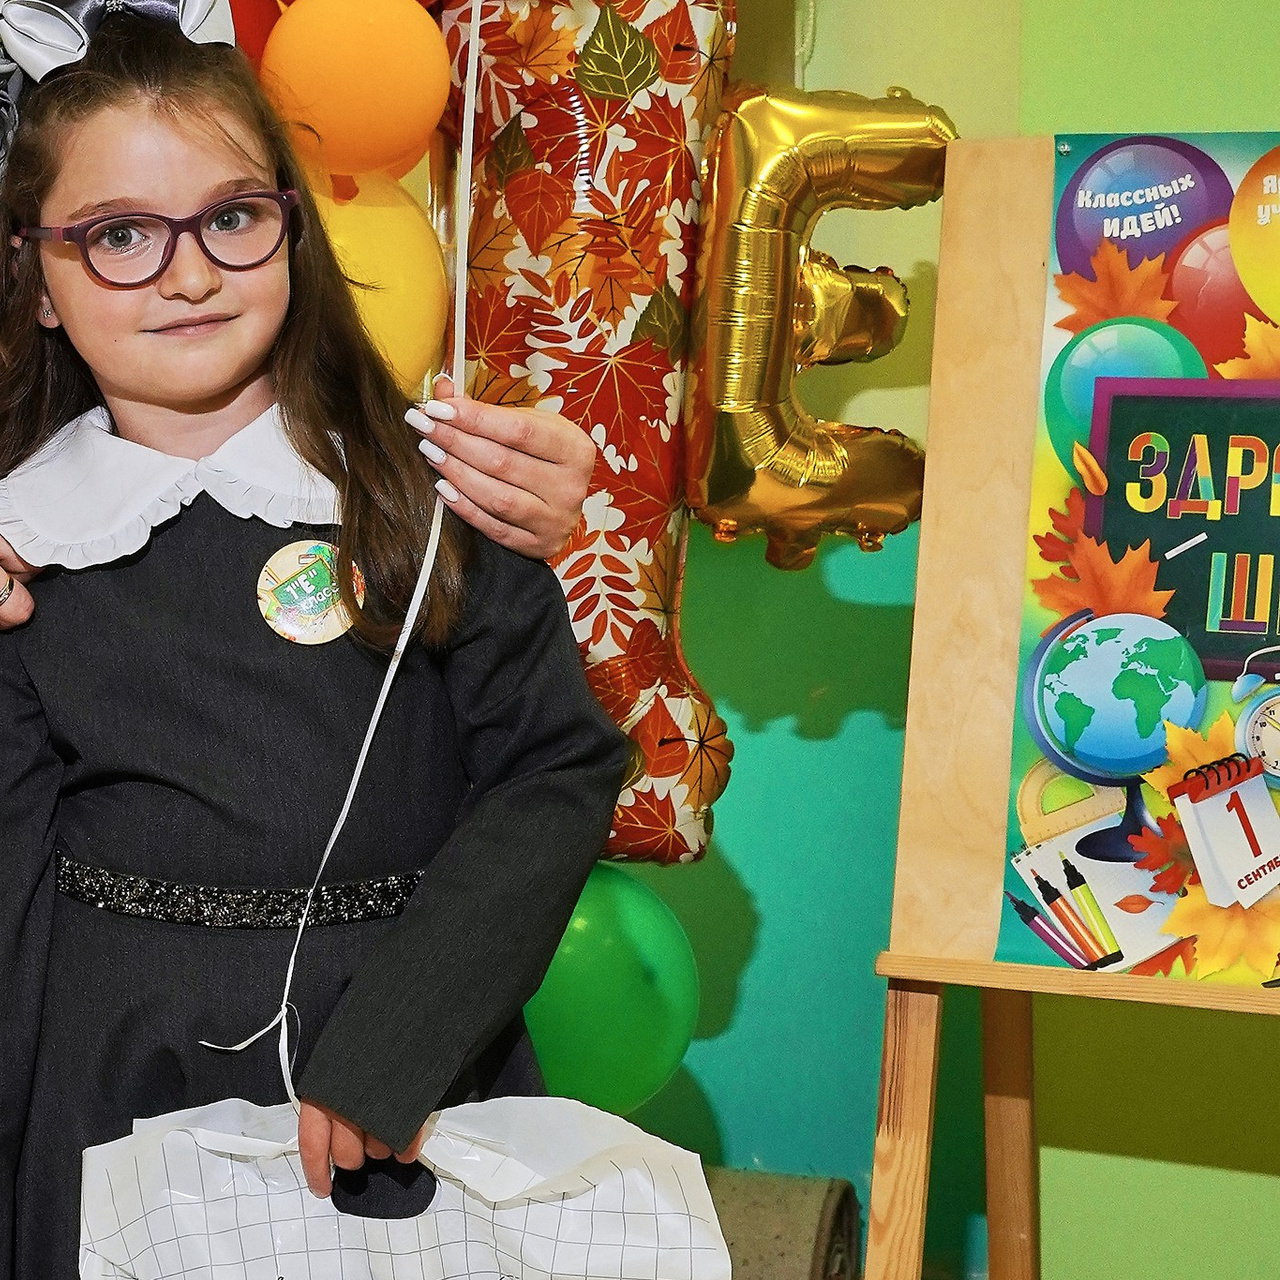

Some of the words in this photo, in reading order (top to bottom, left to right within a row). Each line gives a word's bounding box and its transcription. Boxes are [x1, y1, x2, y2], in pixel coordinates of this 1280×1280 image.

[1077, 173, 1196, 209] Классных
[1103, 201, 1184, 240] ИДЕЙ!
[1226, 790, 1262, 858] 1
